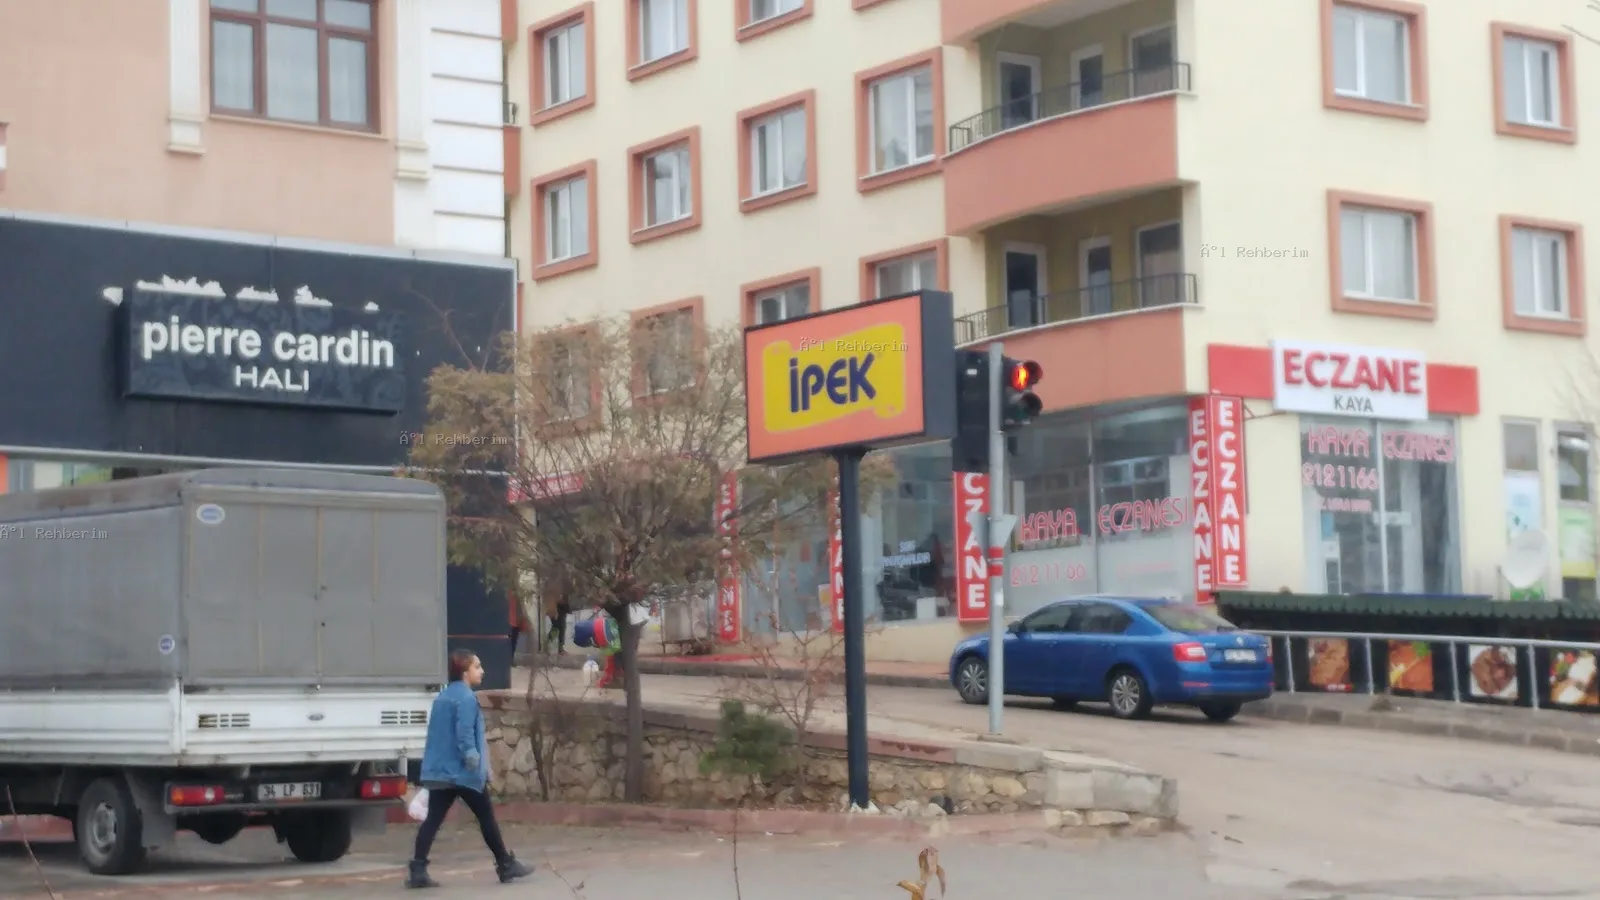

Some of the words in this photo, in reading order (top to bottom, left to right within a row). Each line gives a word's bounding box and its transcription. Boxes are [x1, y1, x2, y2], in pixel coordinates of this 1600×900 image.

[143, 315, 262, 358] pierre
[273, 331, 394, 368] cardin
[234, 364, 310, 393] HALI
[1283, 349, 1423, 395] ECZANE
[1334, 393, 1374, 413] KAYA
[1191, 409, 1212, 591] ECZANE
[1218, 400, 1241, 582] ECZANE
[963, 472, 988, 608] CZANE
[1020, 508, 1080, 542] KAYA
